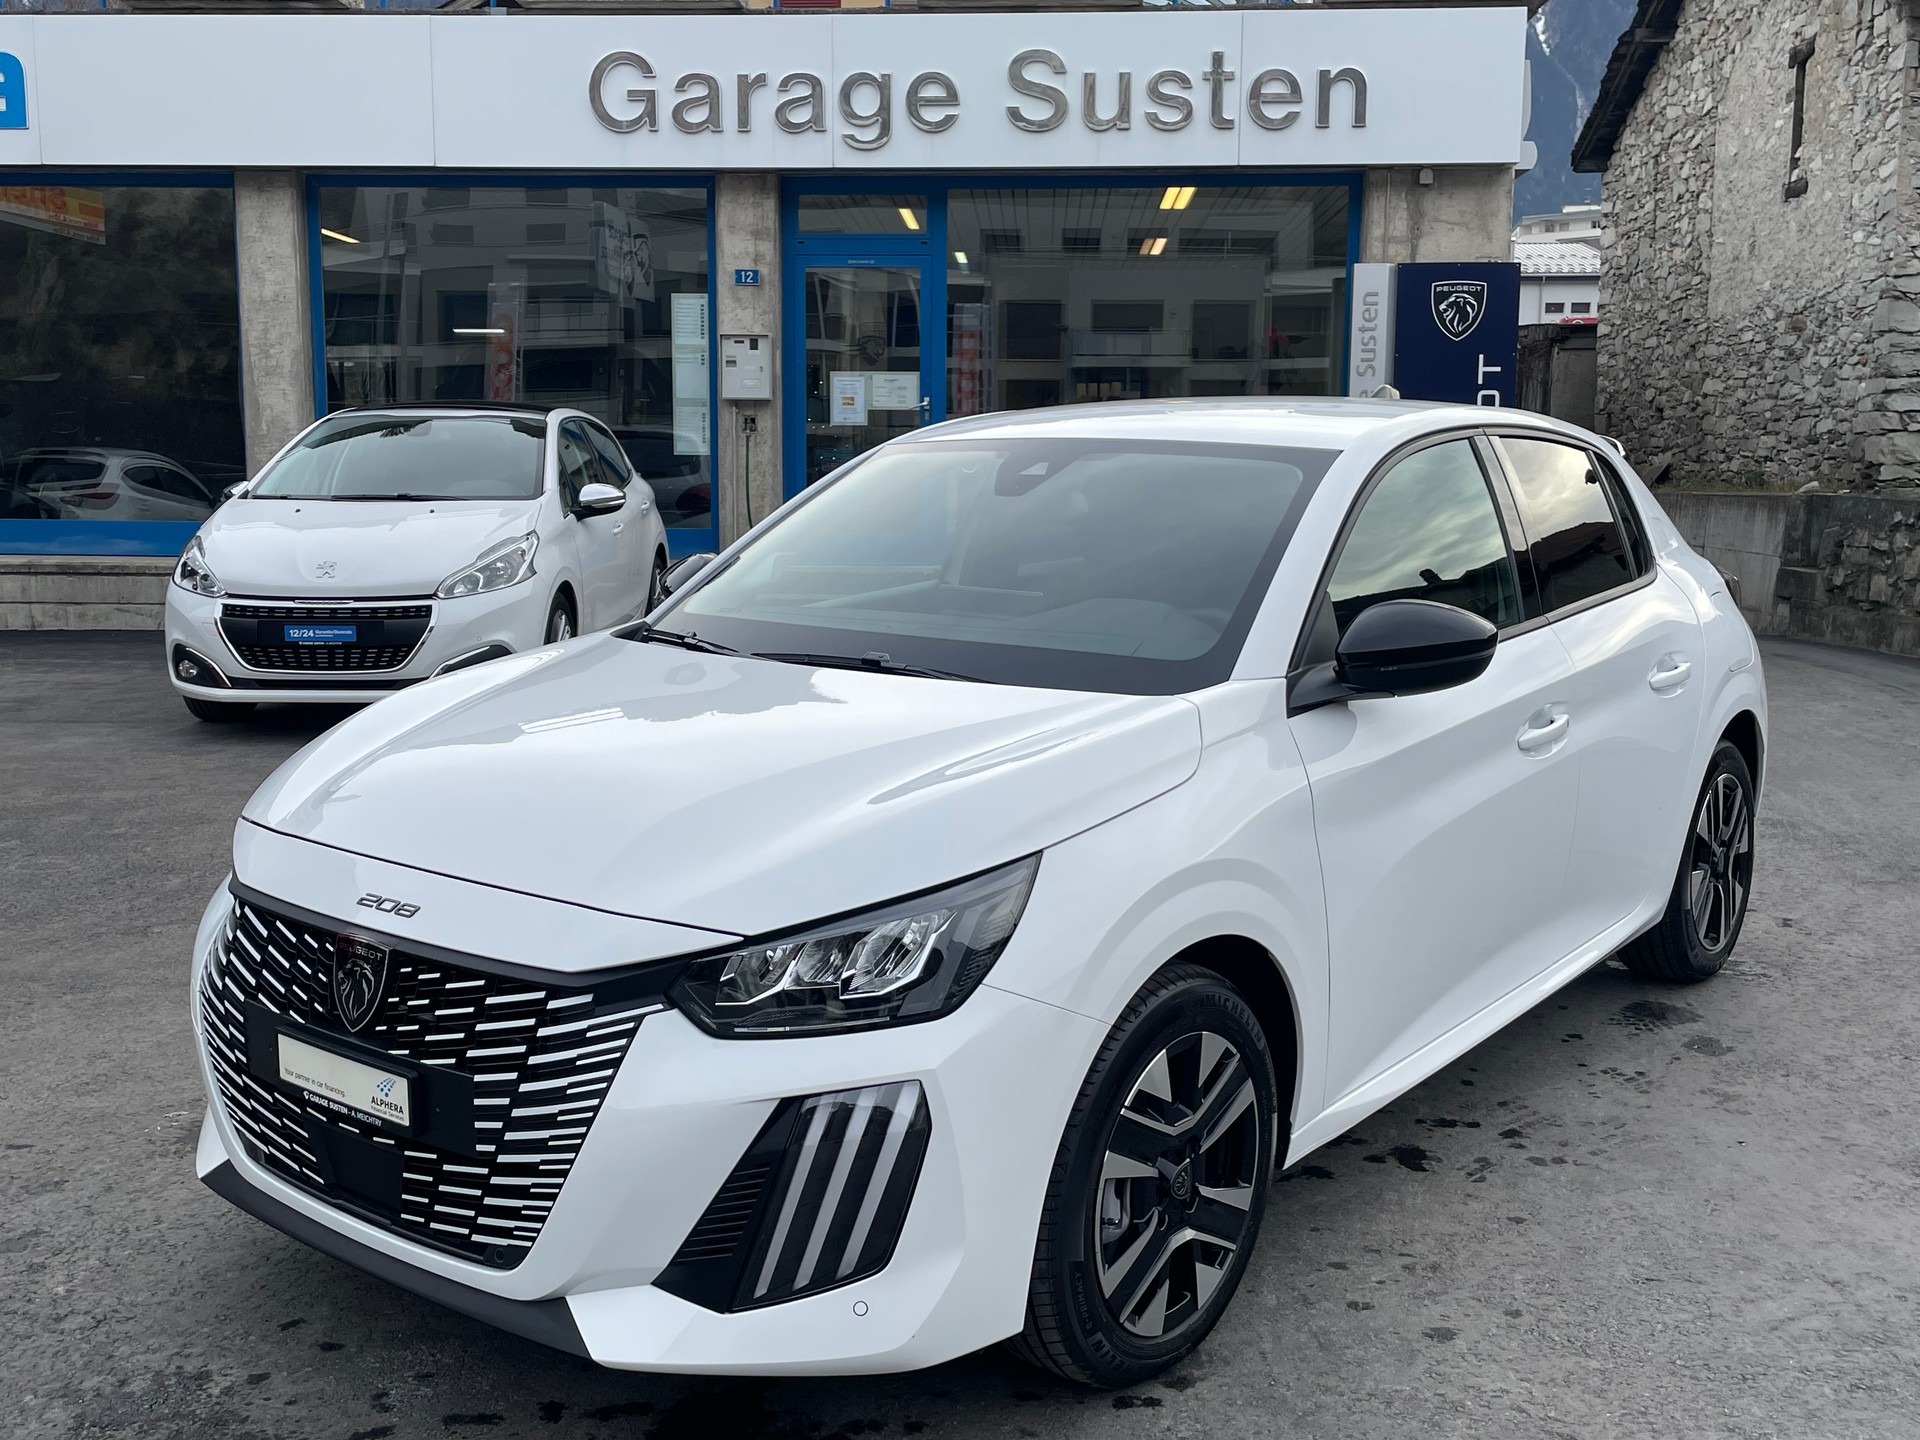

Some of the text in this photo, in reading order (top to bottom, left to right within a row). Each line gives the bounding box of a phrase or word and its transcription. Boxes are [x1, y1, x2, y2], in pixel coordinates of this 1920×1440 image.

[588, 48, 1368, 151] Garage Susten
[741, 271, 754, 283] 12
[1356, 291, 1379, 377] Susten
[289, 629, 314, 638] 12/24
[356, 892, 421, 918] 208
[338, 942, 383, 961] PEUGEOT
[1205, 993, 1264, 1044] MICHELIN
[284, 1067, 294, 1076] Your
[294, 1072, 311, 1083] partner
[309, 1093, 329, 1107] GARAGE
[329, 1101, 348, 1115] SUSTEN
[371, 1096, 404, 1114] ALPHERA
[371, 1105, 405, 1121] Financial Services
